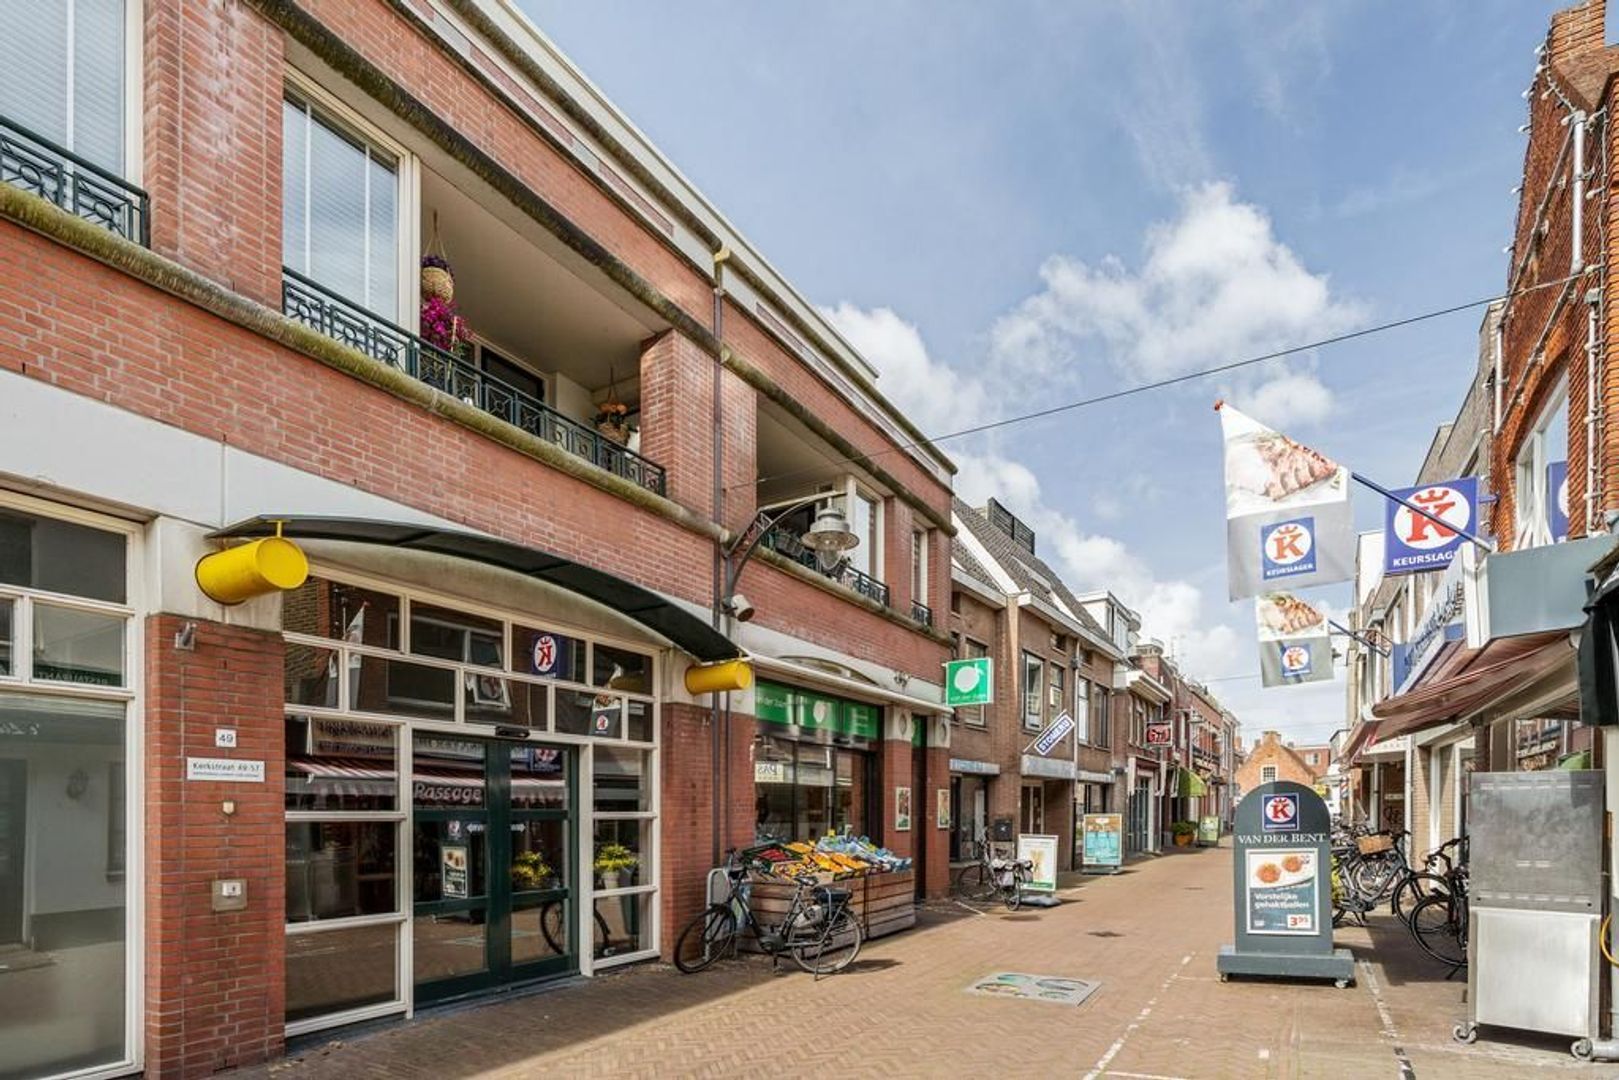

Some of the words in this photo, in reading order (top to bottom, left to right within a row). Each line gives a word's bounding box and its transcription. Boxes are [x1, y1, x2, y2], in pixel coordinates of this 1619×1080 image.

[1274, 532, 1304, 560] K
[1393, 550, 1457, 567] KEURSLAG
[1266, 563, 1313, 577] KEURSLAGER
[219, 734, 233, 743] 49
[1238, 834, 1261, 844] VAN
[1263, 834, 1289, 843] DER
[1291, 832, 1326, 843] BENT
